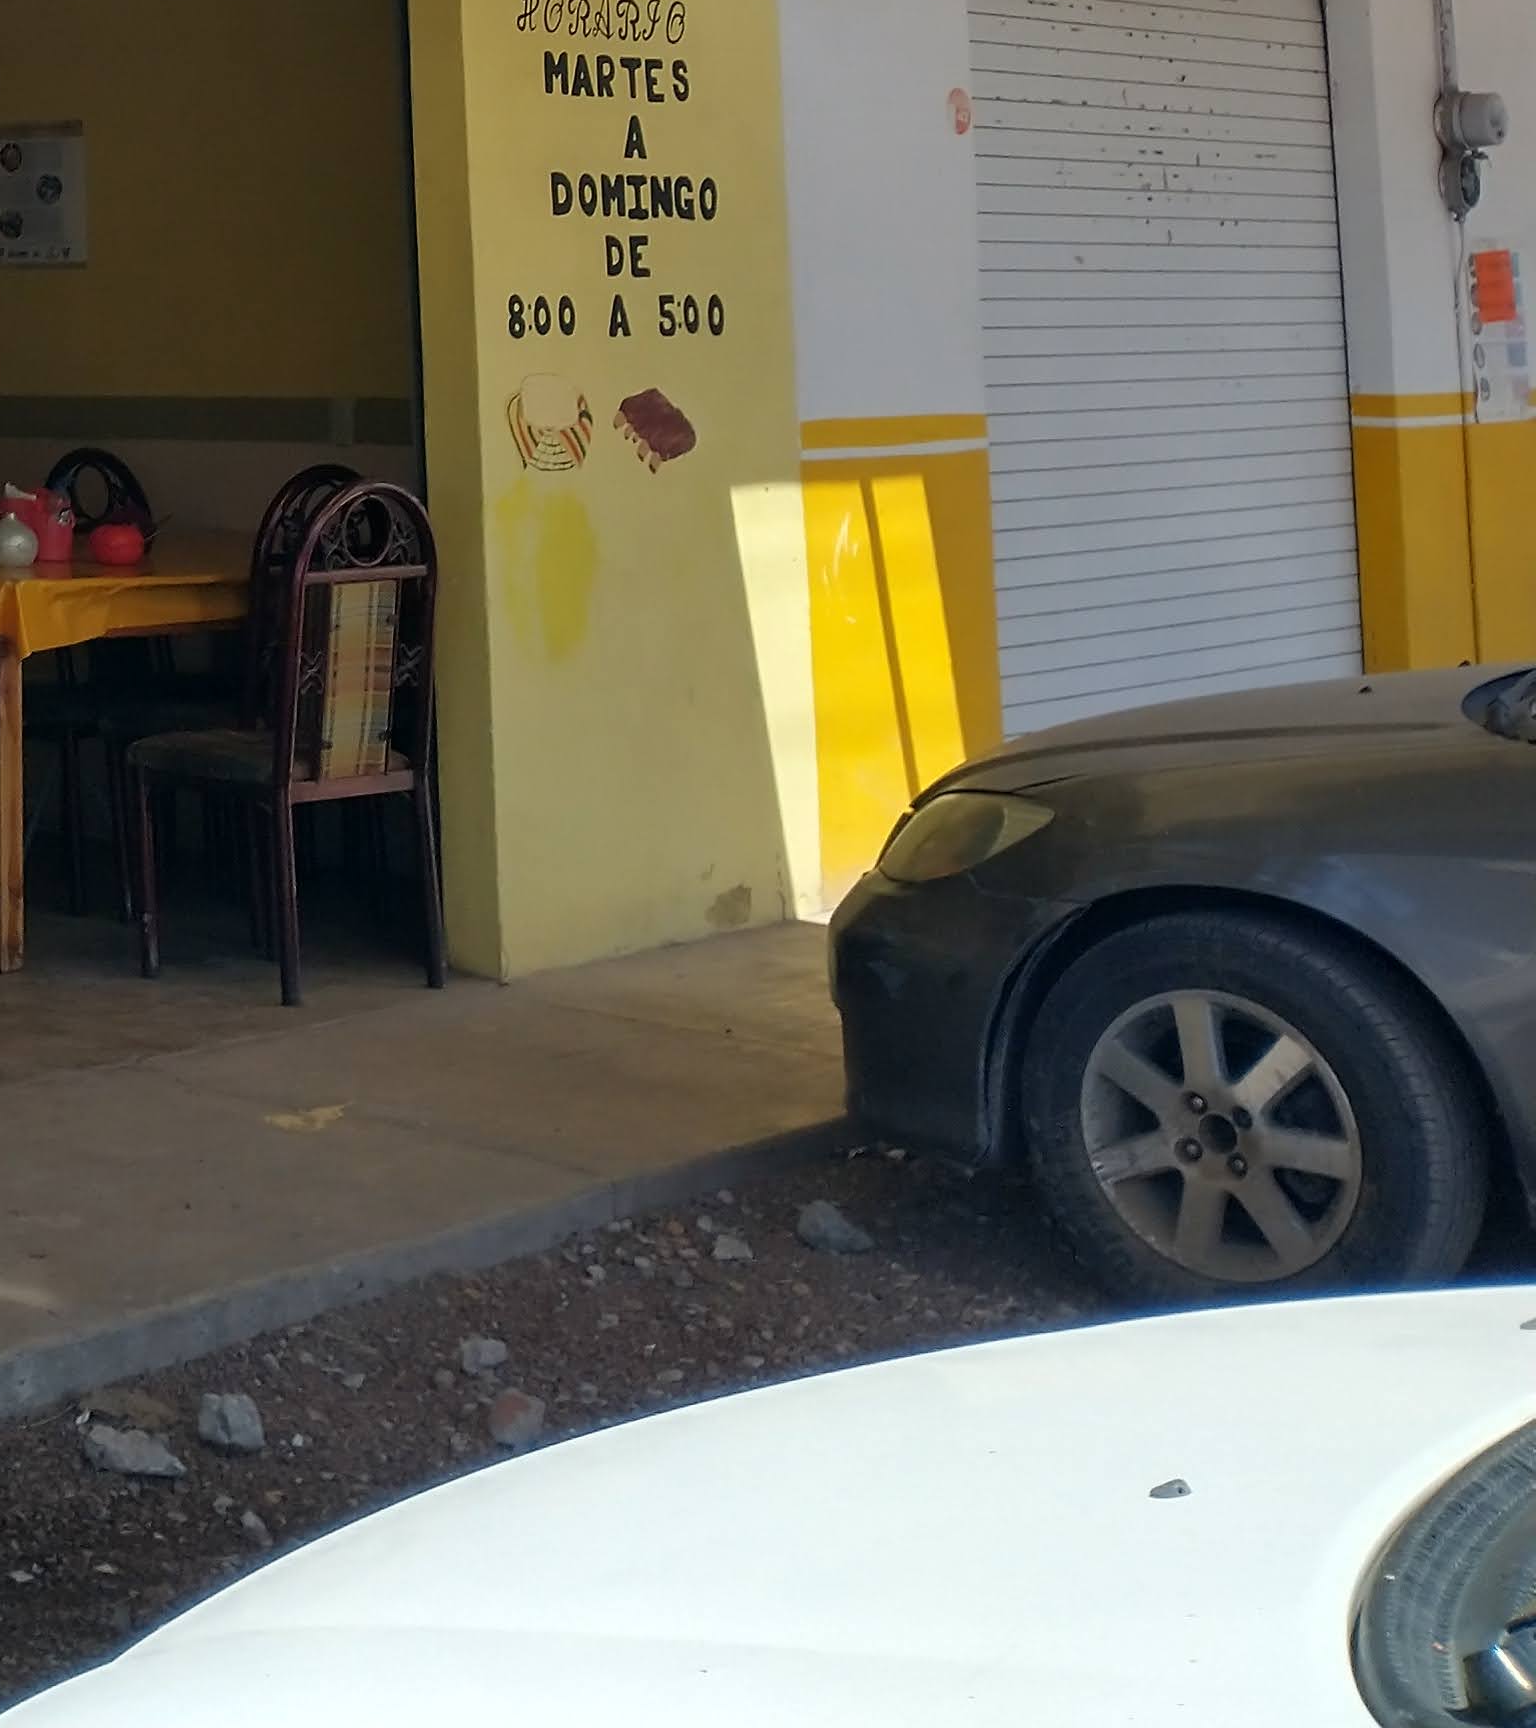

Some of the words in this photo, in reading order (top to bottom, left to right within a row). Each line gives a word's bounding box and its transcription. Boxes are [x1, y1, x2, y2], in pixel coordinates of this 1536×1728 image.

[543, 50, 690, 102] MARTES
[623, 114, 648, 160] A
[550, 171, 718, 221] DOMINGO
[604, 234, 652, 278] DE
[508, 293, 576, 340] 8:00
[608, 293, 632, 338] A
[658, 293, 725, 338] 5:00
